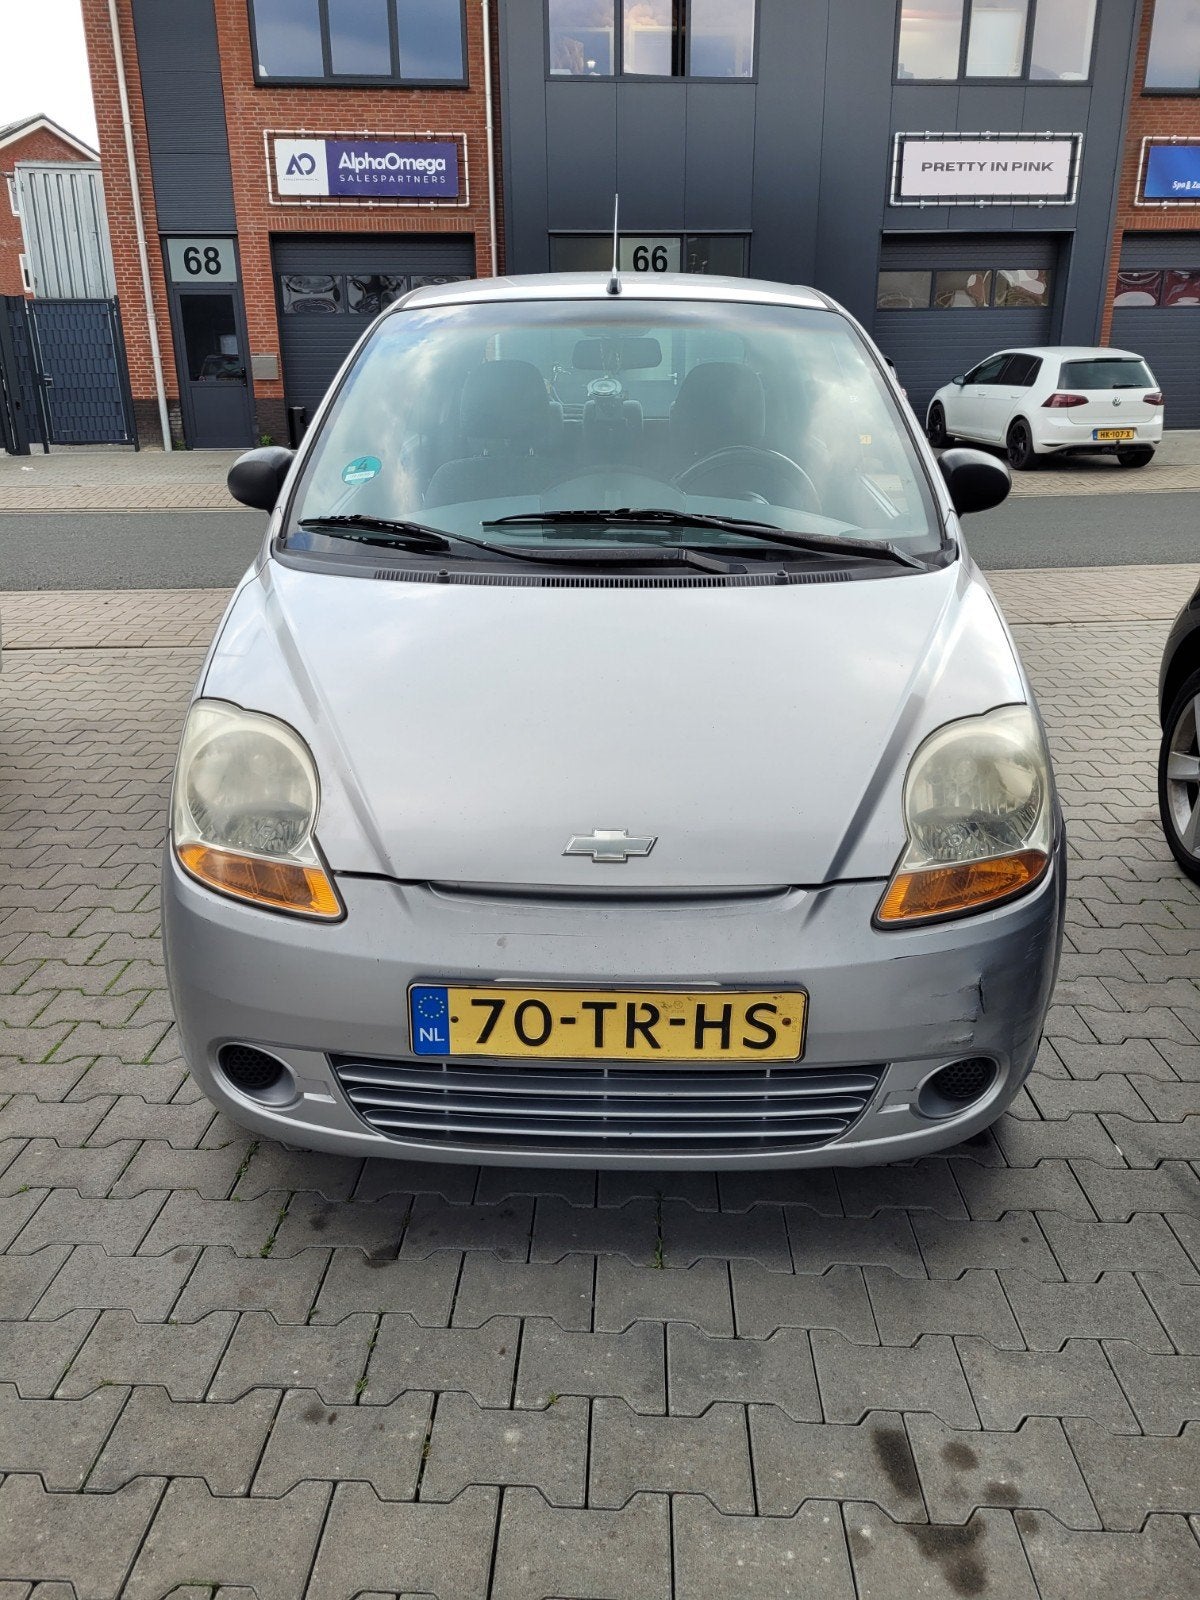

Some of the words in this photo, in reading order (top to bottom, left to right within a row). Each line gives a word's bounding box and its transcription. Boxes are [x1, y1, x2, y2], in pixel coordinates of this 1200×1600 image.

[338, 152, 446, 174] AlphaOmega
[921, 161, 986, 172] PRETTY
[990, 161, 1008, 172] IN
[1011, 161, 1054, 172] PINK
[340, 174, 446, 184] SALESPARTNERS
[1172, 180, 1186, 190] Spa
[183, 246, 222, 275] 68
[632, 245, 668, 272] 66
[1100, 431, 1131, 439] HK-107-X
[471, 998, 778, 1050] 70-TR-HS
[419, 1027, 445, 1042] NL
